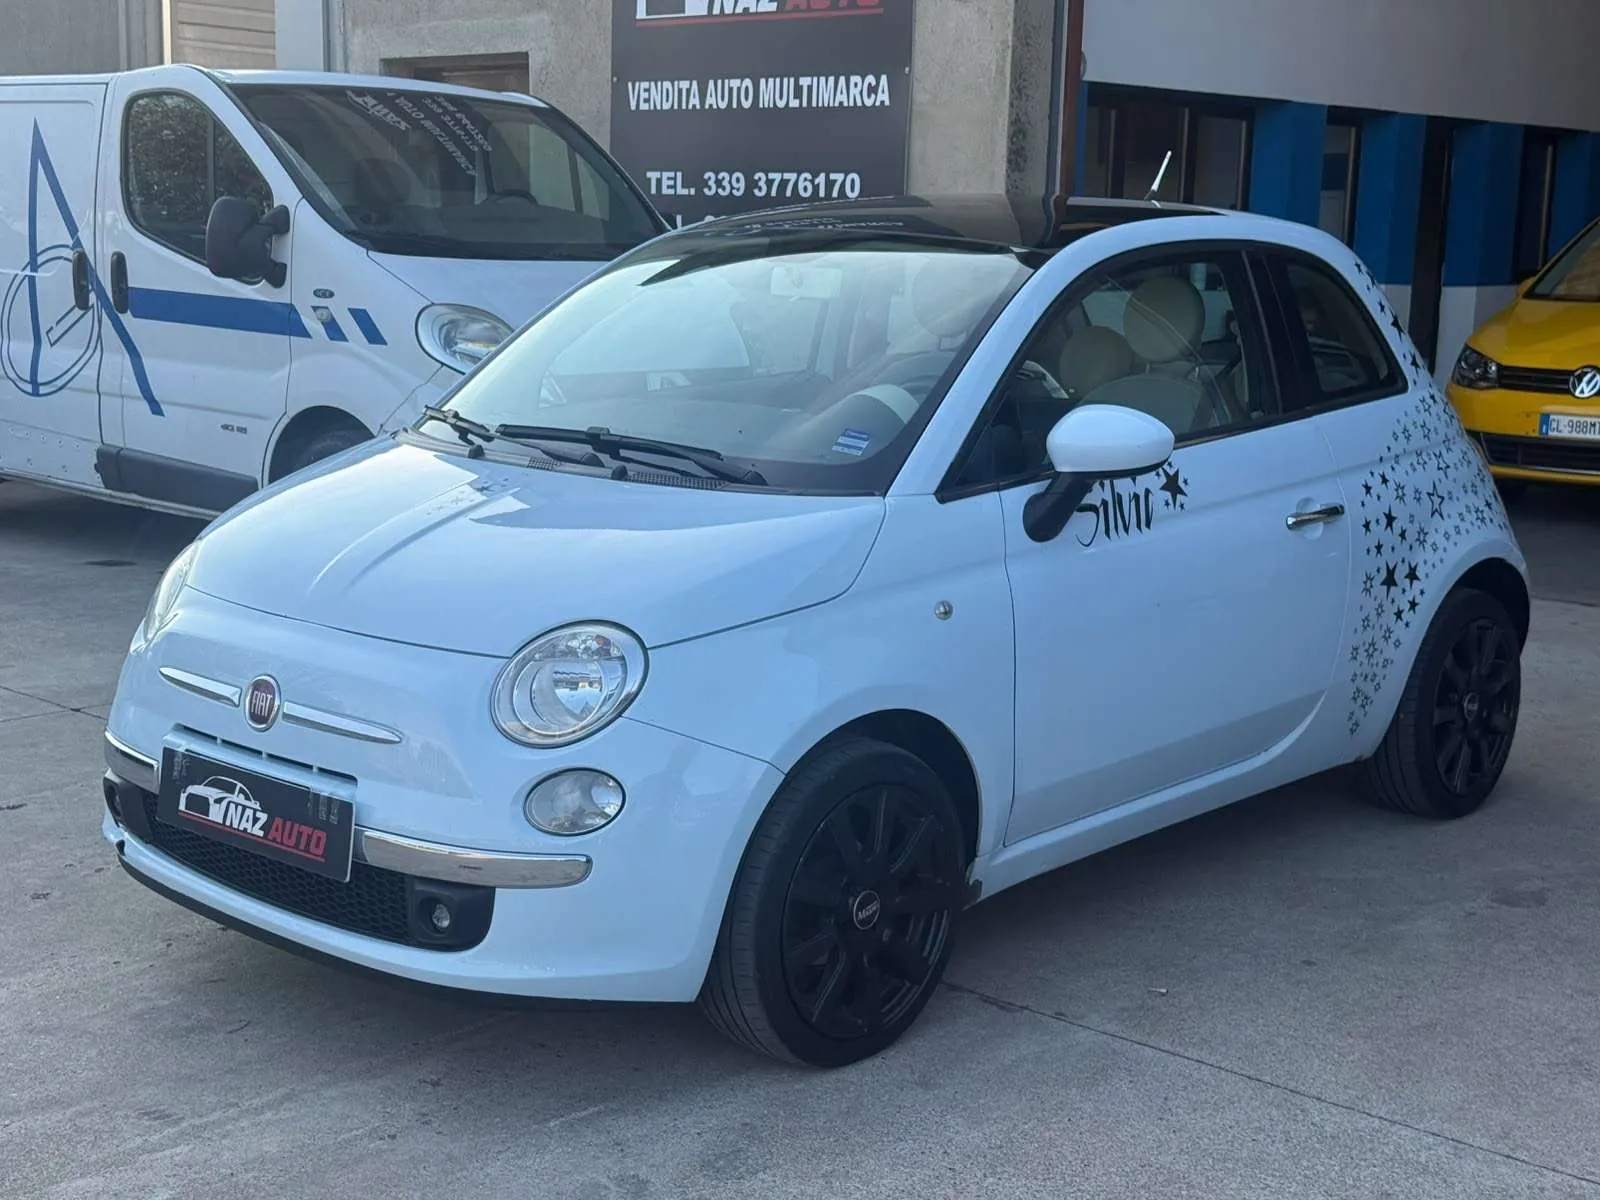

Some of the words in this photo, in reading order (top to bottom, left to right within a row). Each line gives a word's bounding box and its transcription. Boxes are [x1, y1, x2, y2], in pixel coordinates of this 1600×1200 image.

[628, 79, 701, 111] VENDITA
[705, 77, 754, 109] AUTO
[758, 74, 891, 109] MULTIMARCA
[646, 171, 696, 196] TEL.
[703, 171, 746, 197] 339
[753, 172, 861, 199] 3776170
[251, 690, 273, 717] FIAT
[225, 802, 269, 837] NAZ
[269, 817, 327, 855] AUTO
